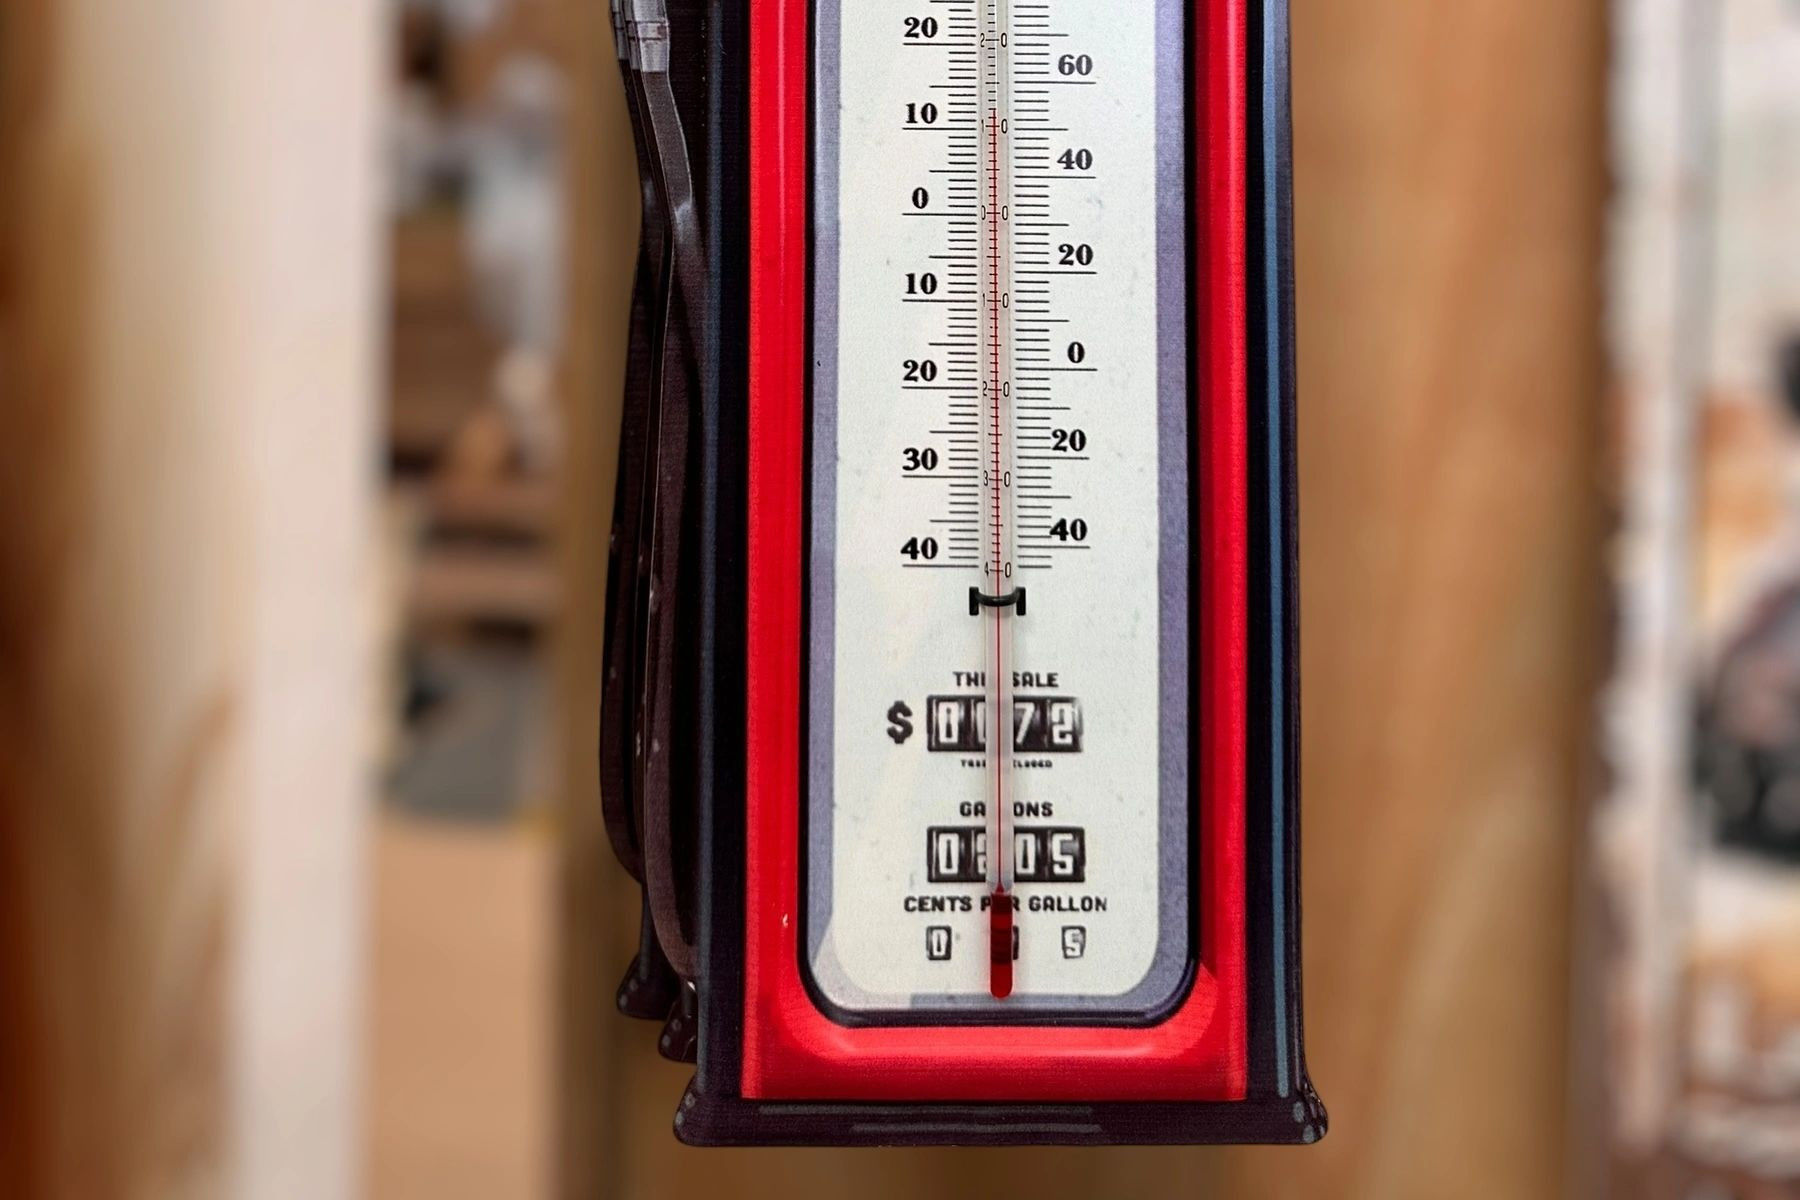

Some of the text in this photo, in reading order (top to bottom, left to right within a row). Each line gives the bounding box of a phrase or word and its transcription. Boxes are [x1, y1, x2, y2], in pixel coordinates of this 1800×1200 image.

[904, 17, 937, 38] 20
[1059, 55, 1092, 75] 60
[907, 103, 937, 124] 10
[1057, 149, 1092, 170] 40
[912, 188, 928, 209] 0
[1059, 244, 1093, 265] 20
[906, 273, 937, 294] 10
[1068, 342, 1084, 363] 0
[903, 360, 937, 382] 20
[1052, 429, 1086, 452] 20
[903, 448, 937, 470] 30
[1050, 517, 1087, 541] 40
[901, 537, 938, 560] 40
[953, 671, 986, 688] THI
[887, 701, 913, 744] $
[959, 801, 1053, 818] GAONS
[904, 895, 1108, 912] CENTS PR GALLON
